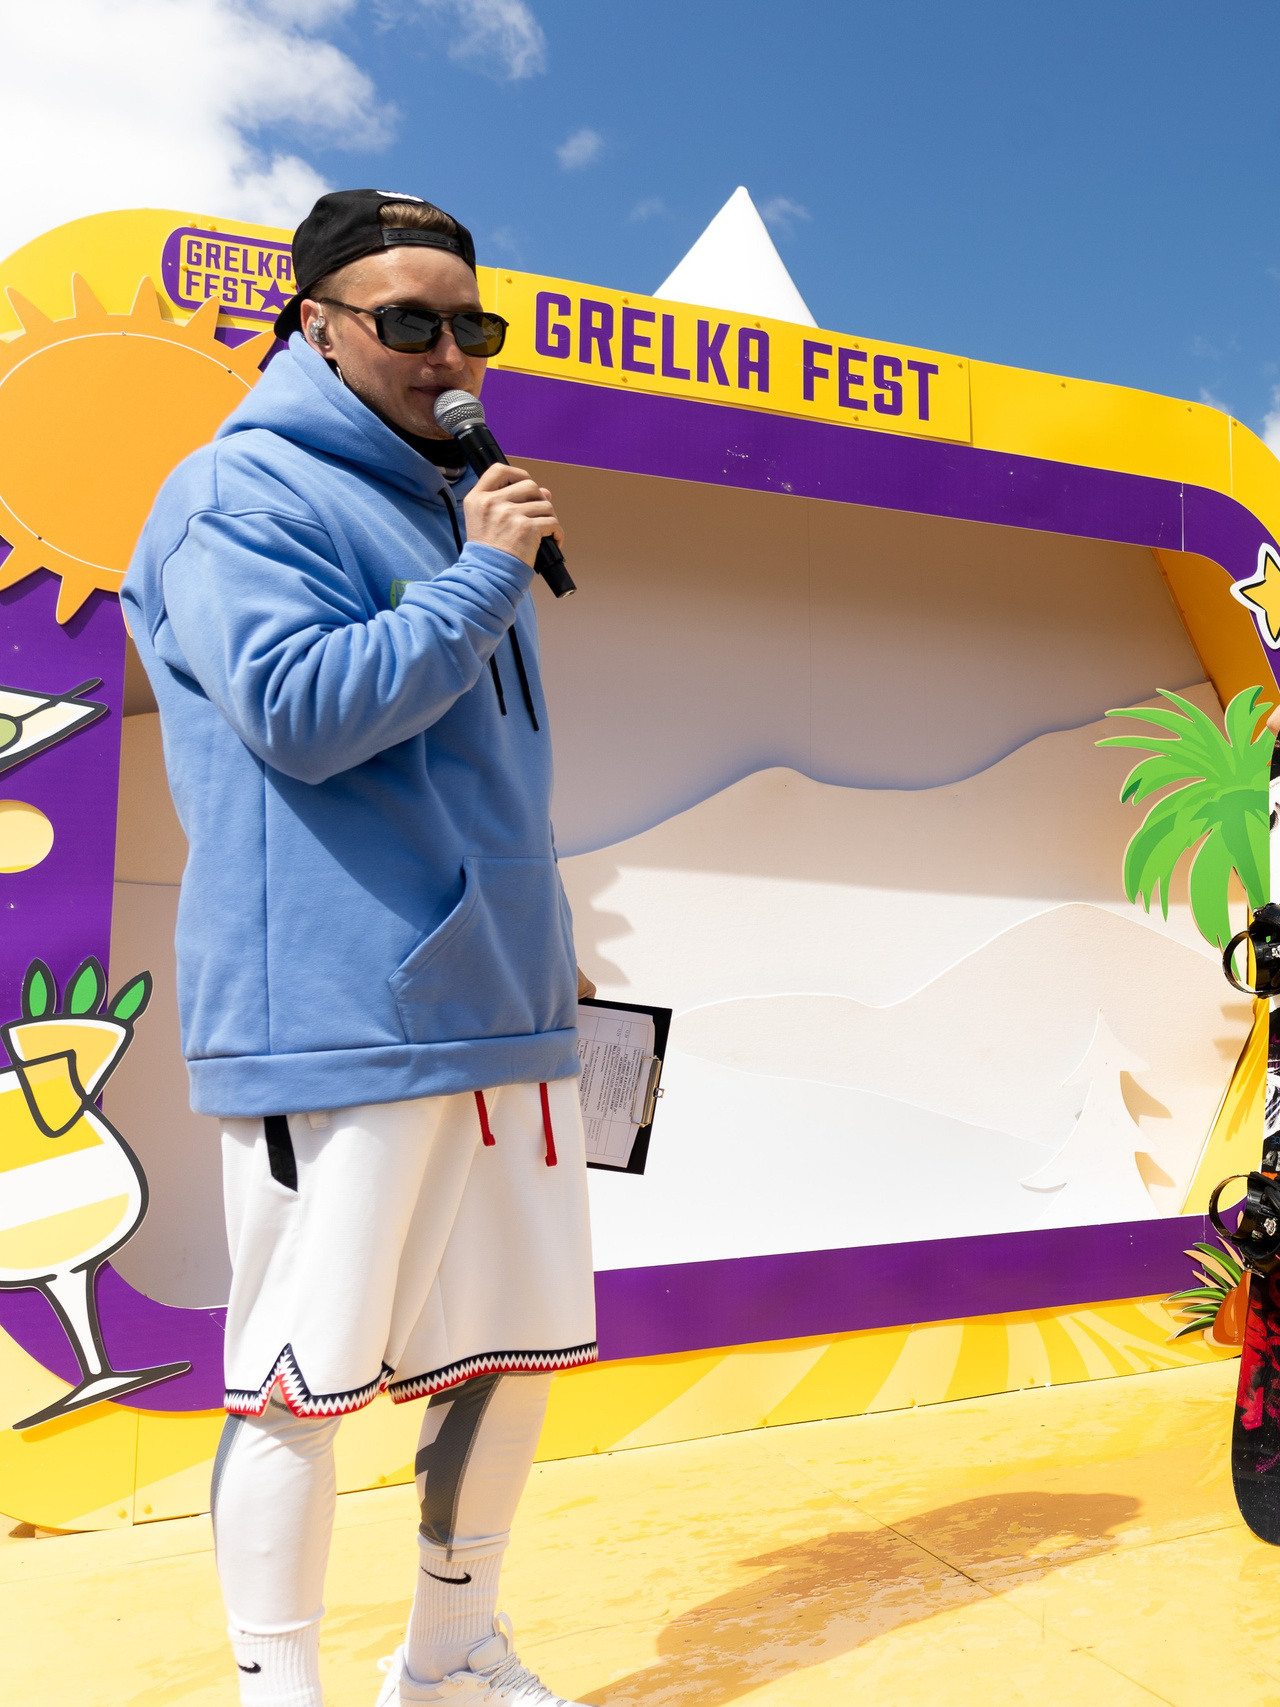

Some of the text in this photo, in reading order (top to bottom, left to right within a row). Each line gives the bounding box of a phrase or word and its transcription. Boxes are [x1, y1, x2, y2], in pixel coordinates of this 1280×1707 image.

[187, 240, 292, 281] GRELKA
[186, 271, 258, 305] FEST
[535, 291, 939, 421] GRELKA FEST
